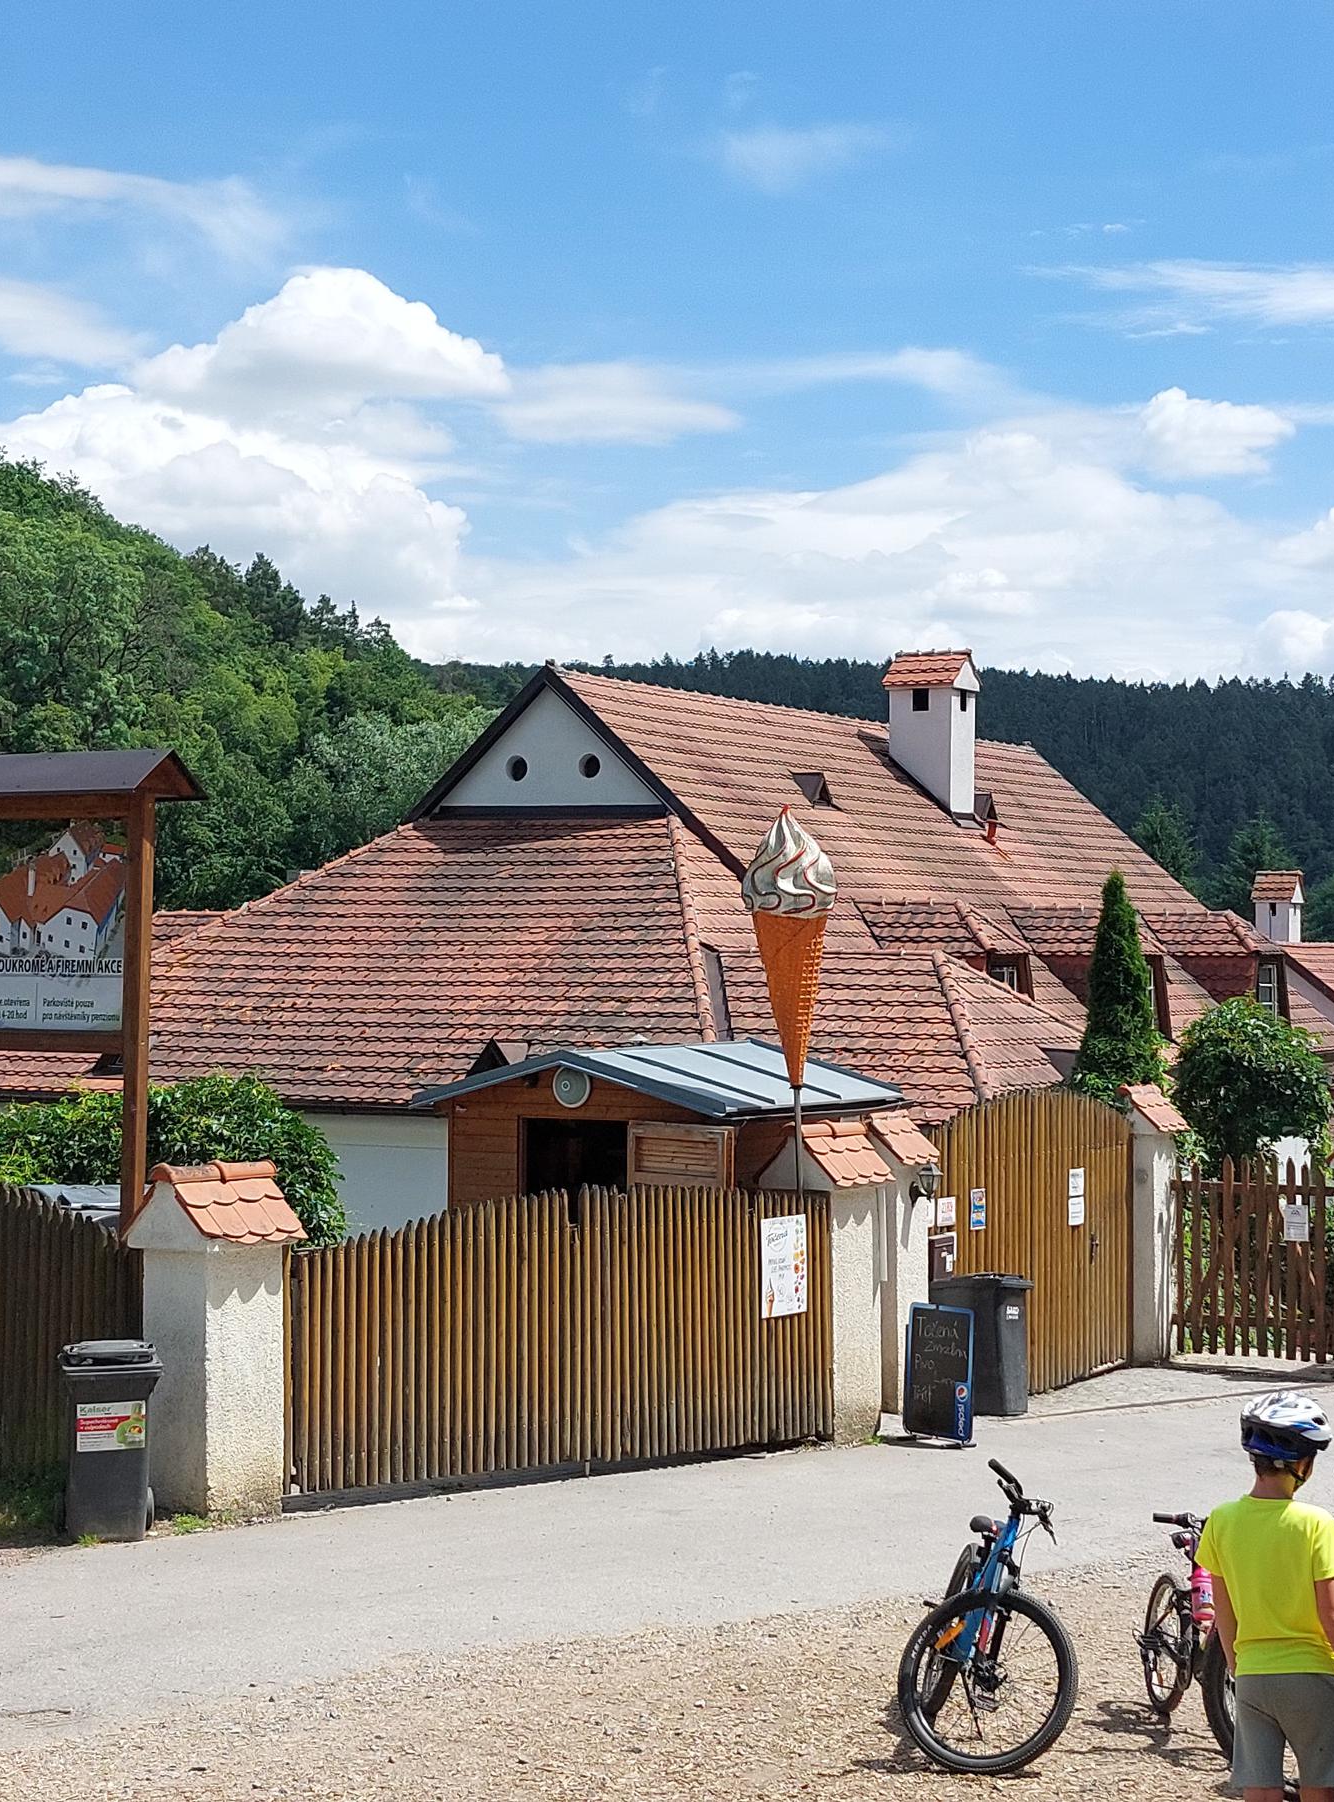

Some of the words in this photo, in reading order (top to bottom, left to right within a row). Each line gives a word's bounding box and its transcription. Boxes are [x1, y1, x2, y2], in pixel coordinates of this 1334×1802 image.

[47, 960, 55, 974] A
[56, 957, 96, 974] FIREMNÍ
[97, 960, 122, 974] AKCE
[75, 1000, 94, 1009] pouze
[42, 1013, 53, 1023] pro
[79, 1405, 112, 1414] Kaiser
